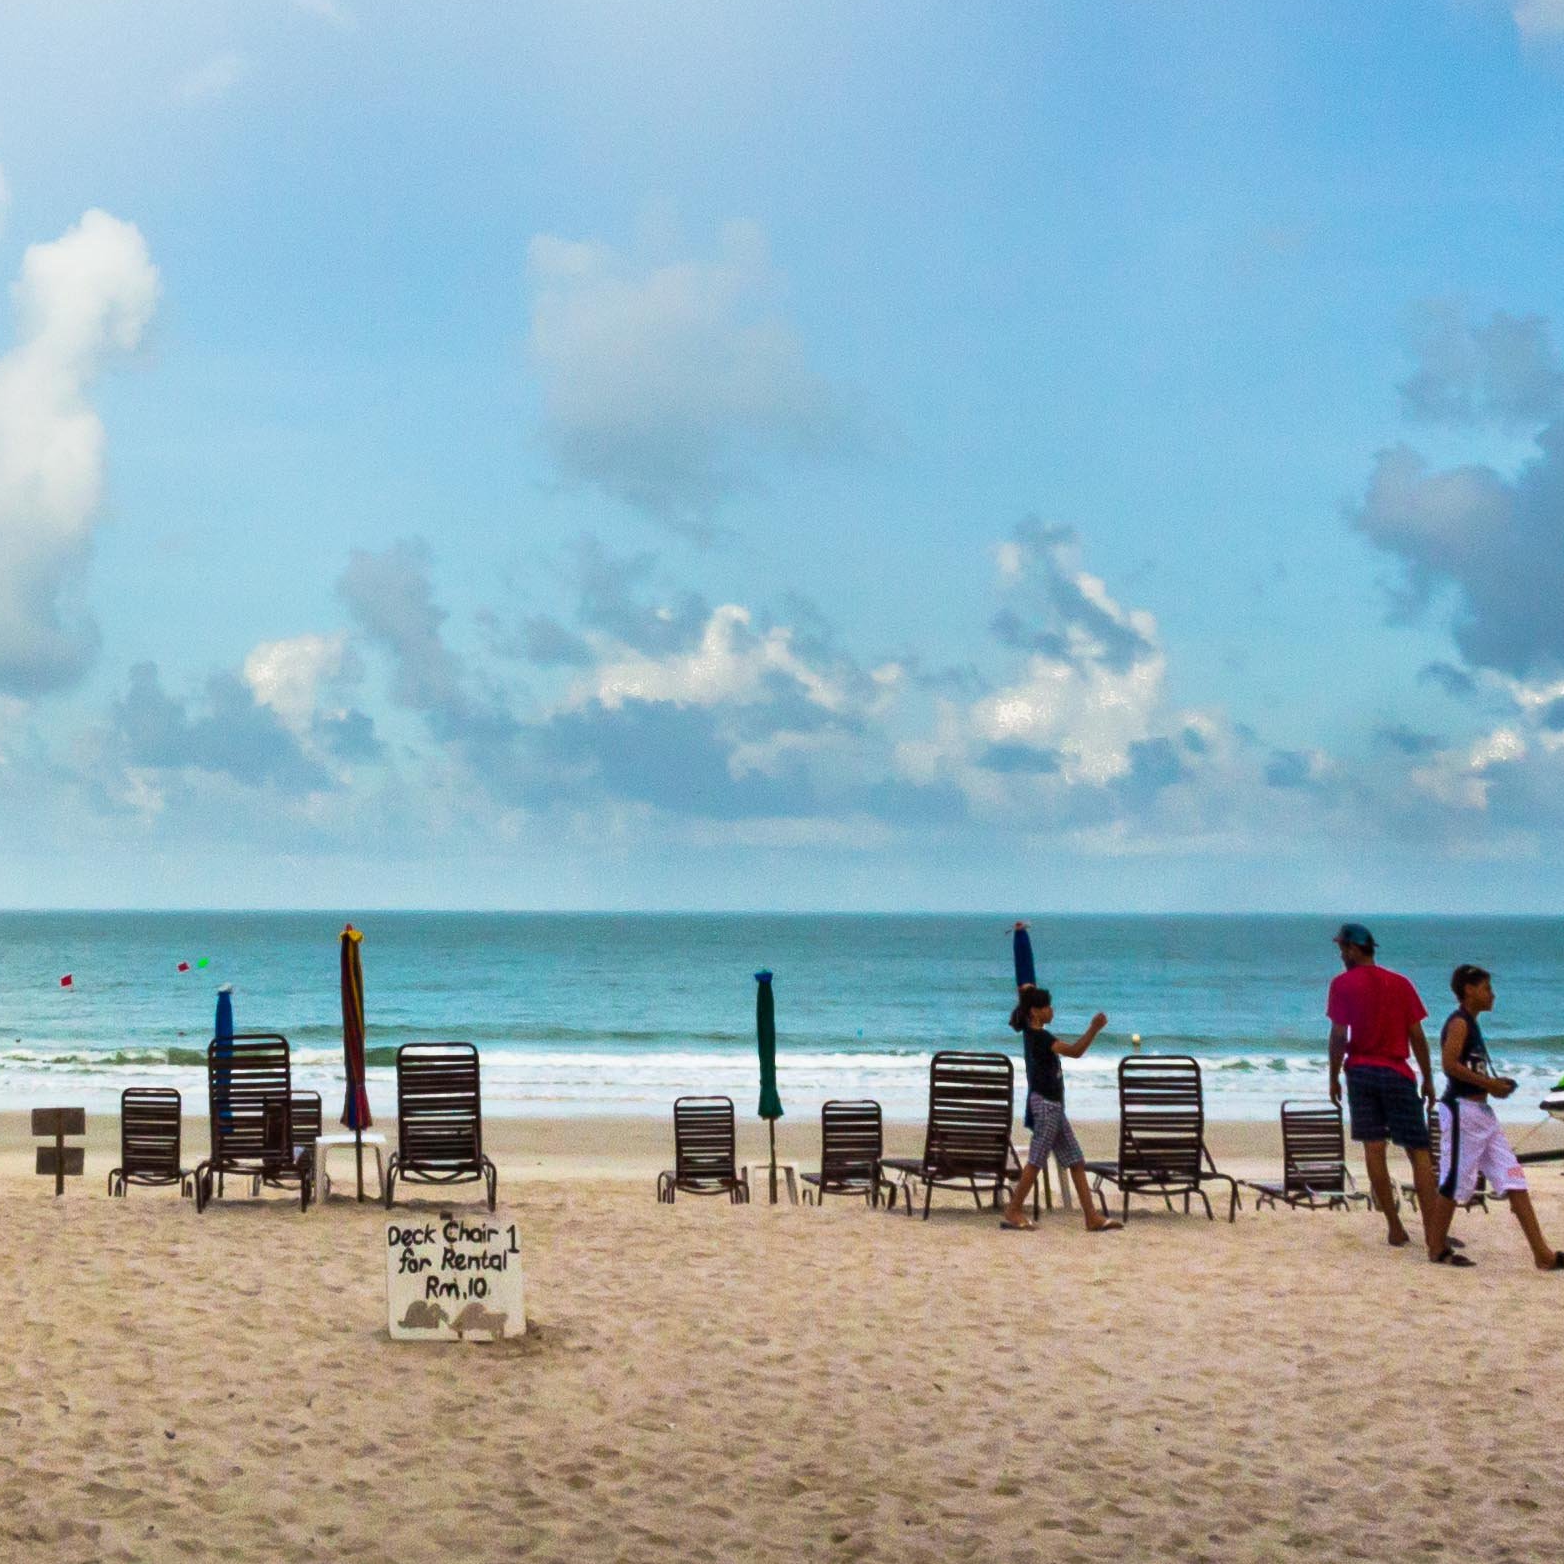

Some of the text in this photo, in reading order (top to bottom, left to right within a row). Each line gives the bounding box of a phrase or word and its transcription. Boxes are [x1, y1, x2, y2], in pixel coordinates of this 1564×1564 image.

[388, 1221, 520, 1254] Deck Chair 1
[398, 1247, 507, 1274] for Rental
